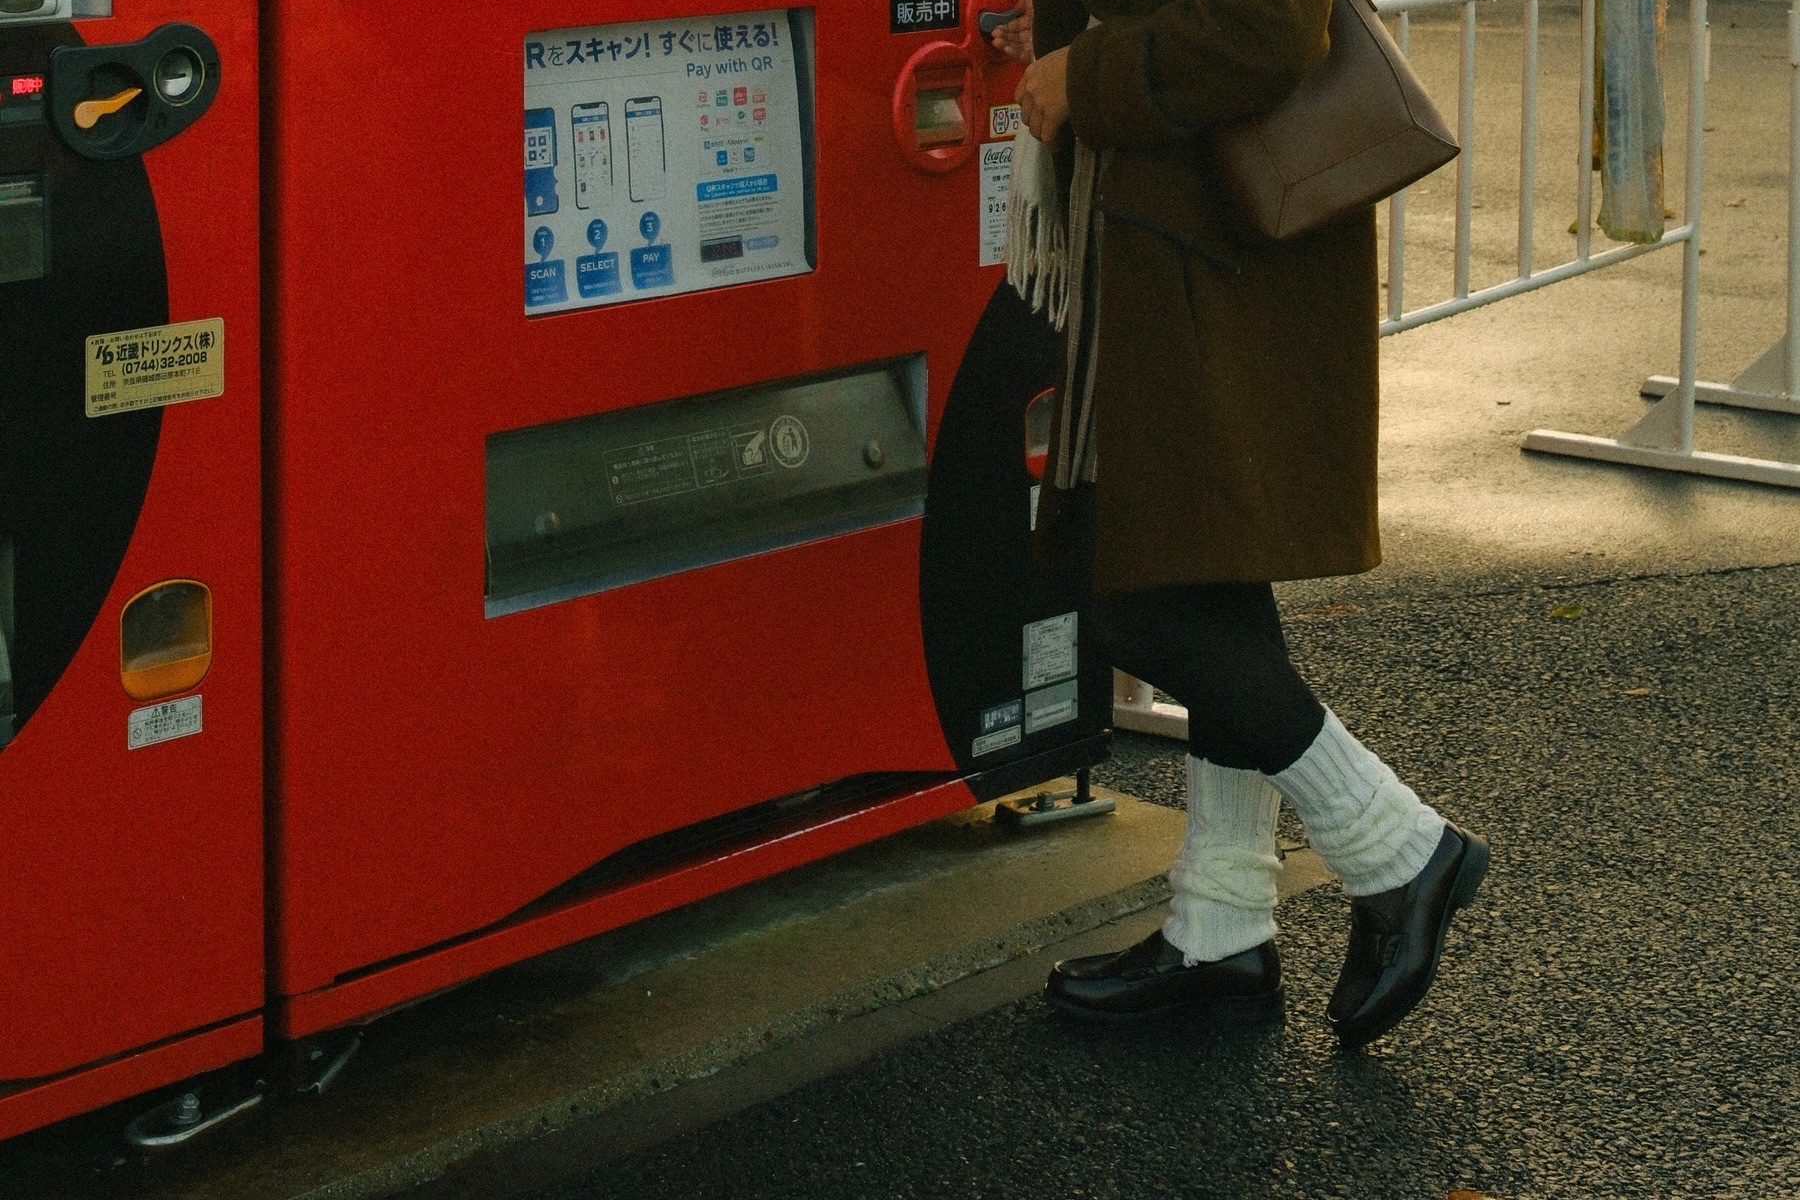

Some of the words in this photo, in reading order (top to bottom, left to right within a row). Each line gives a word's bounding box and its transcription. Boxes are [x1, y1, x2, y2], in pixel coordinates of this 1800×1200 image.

[658, 21, 780, 58] すぐに使える!
[686, 62, 712, 78] Pay
[715, 60, 747, 74] with
[751, 55, 774, 71] QR
[12, 76, 43, 95] 販売中
[594, 229, 601, 240] 2
[646, 221, 653, 233] 3
[540, 236, 546, 247] 1
[580, 257, 616, 273] SELECT
[642, 252, 660, 263] PAY
[530, 267, 557, 280] SCAN
[116, 331, 216, 362] 近畿ドリンクス(株)
[121, 351, 208, 376] (0744)32-2008
